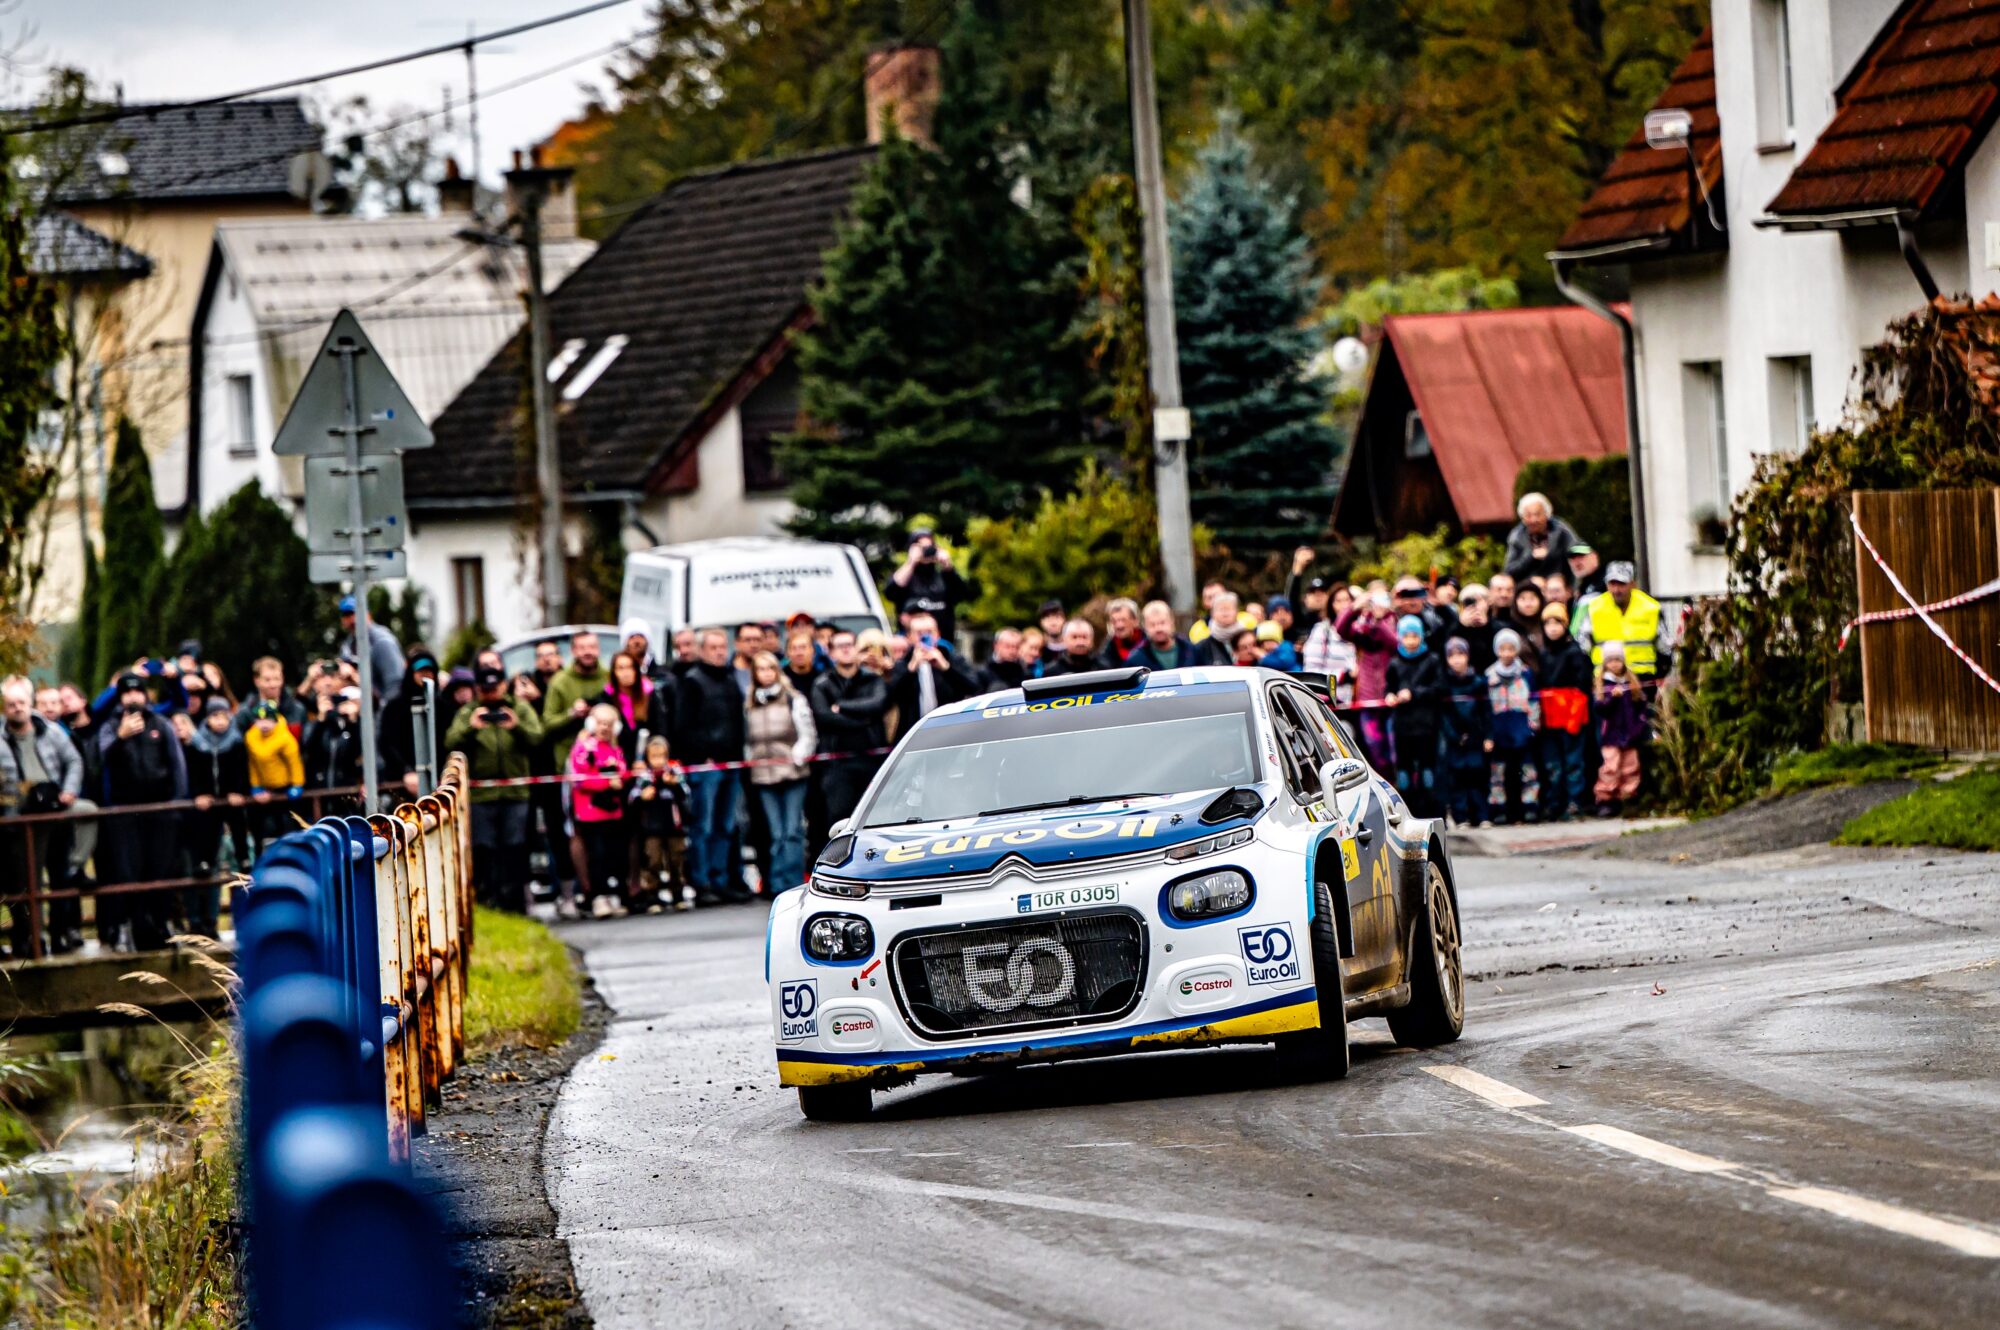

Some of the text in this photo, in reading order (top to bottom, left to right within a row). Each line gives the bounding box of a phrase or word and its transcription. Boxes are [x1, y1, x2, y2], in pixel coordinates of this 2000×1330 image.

[982, 689, 1179, 719] EuroOil team
[884, 816, 1161, 863] EuroOil
[1035, 891, 1065, 908] 10R
[1071, 885, 1115, 903] 0305
[1242, 927, 1292, 964] EO
[963, 937, 1076, 1013] EO
[1194, 978, 1232, 992] Castrol
[782, 983, 816, 1019] EO
[843, 1019, 874, 1032] Castrol
